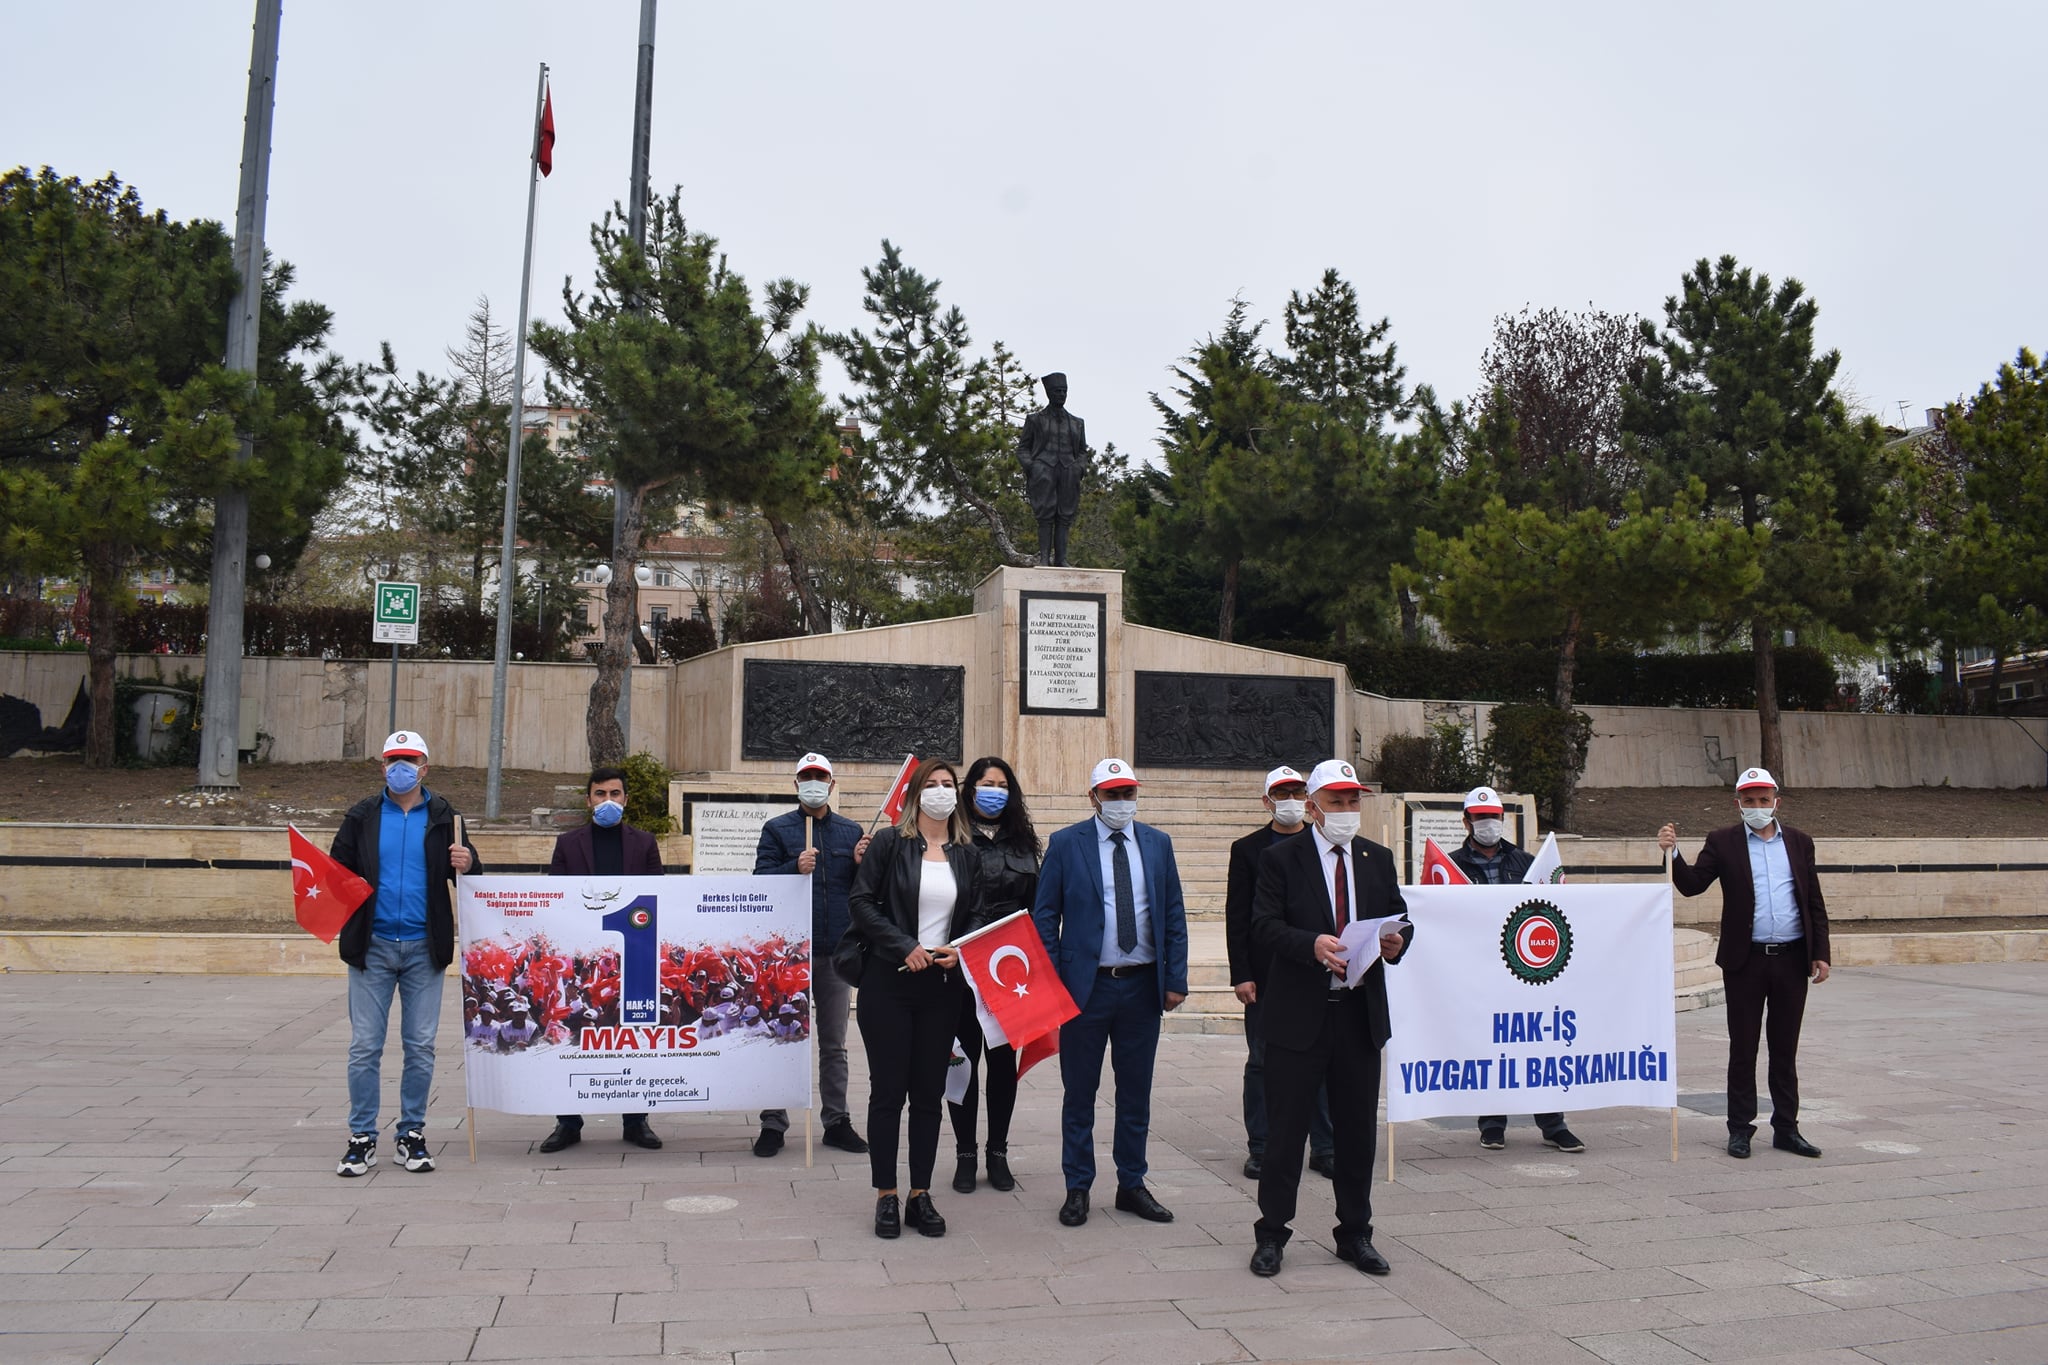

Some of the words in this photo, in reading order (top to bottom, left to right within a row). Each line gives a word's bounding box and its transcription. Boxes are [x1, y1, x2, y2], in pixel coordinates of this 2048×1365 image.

[474, 891, 498, 899] Adalet,
[529, 891, 564, 900] Güvenceyi
[703, 894, 730, 902] Herkes
[732, 893, 748, 904] İçin
[749, 894, 768, 902] Gelir
[504, 908, 534, 916] İstiyoruz
[697, 904, 738, 912] Güvencesi
[740, 904, 774, 913] İstiyoruz
[1530, 938, 1556, 948] HAK-İŞ
[602, 895, 658, 1023] 1
[626, 999, 655, 1011] HAK-İŞ
[1493, 1006, 1577, 1047] HAK-İŞ
[582, 1027, 698, 1051] MAYIS
[1400, 1059, 1492, 1094] YOZGAT
[1498, 1053, 1520, 1089] İL
[1526, 1045, 1668, 1092] BAŞKANLIĞI
[590, 1078, 601, 1086] Bu
[604, 1078, 632, 1088] günler
[636, 1077, 646, 1086] de
[650, 1077, 688, 1088] geçecek,
[578, 1090, 588, 1099] bu
[592, 1089, 640, 1100] meydanlar
[642, 1089, 662, 1100] yine
[664, 1087, 699, 1097] dolacak
